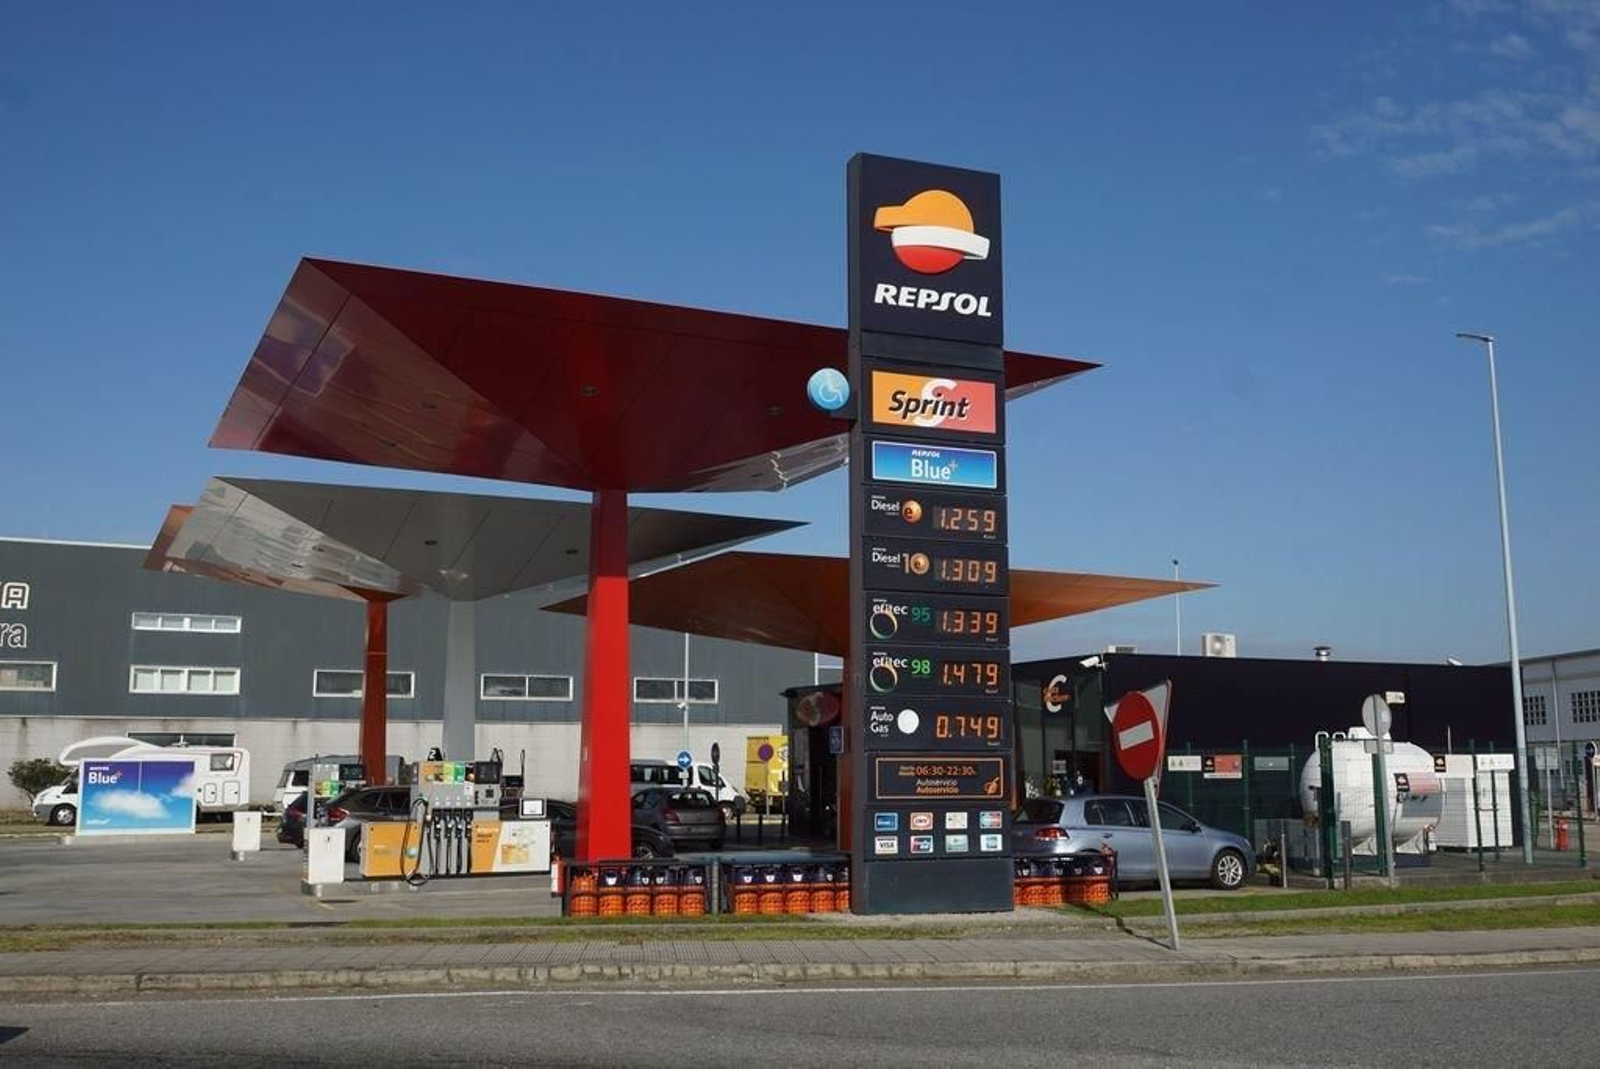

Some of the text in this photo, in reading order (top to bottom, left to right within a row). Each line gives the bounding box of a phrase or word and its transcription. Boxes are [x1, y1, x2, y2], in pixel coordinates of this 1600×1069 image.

[874, 283, 992, 317] REPSOL
[889, 390, 970, 420] Sprint
[871, 499, 900, 512] Diesel
[941, 508, 996, 532] 1.259
[872, 552, 901, 563] Diesel
[941, 560, 997, 583] 1.309
[911, 607, 931, 621] 95
[942, 611, 998, 634] 1.339
[911, 659, 931, 675] 98
[942, 663, 998, 685] 1.479
[870, 711, 894, 721] Auto
[870, 722, 889, 733] Gas
[936, 715, 999, 738] 0.749
[879, 841, 894, 849] VISA
